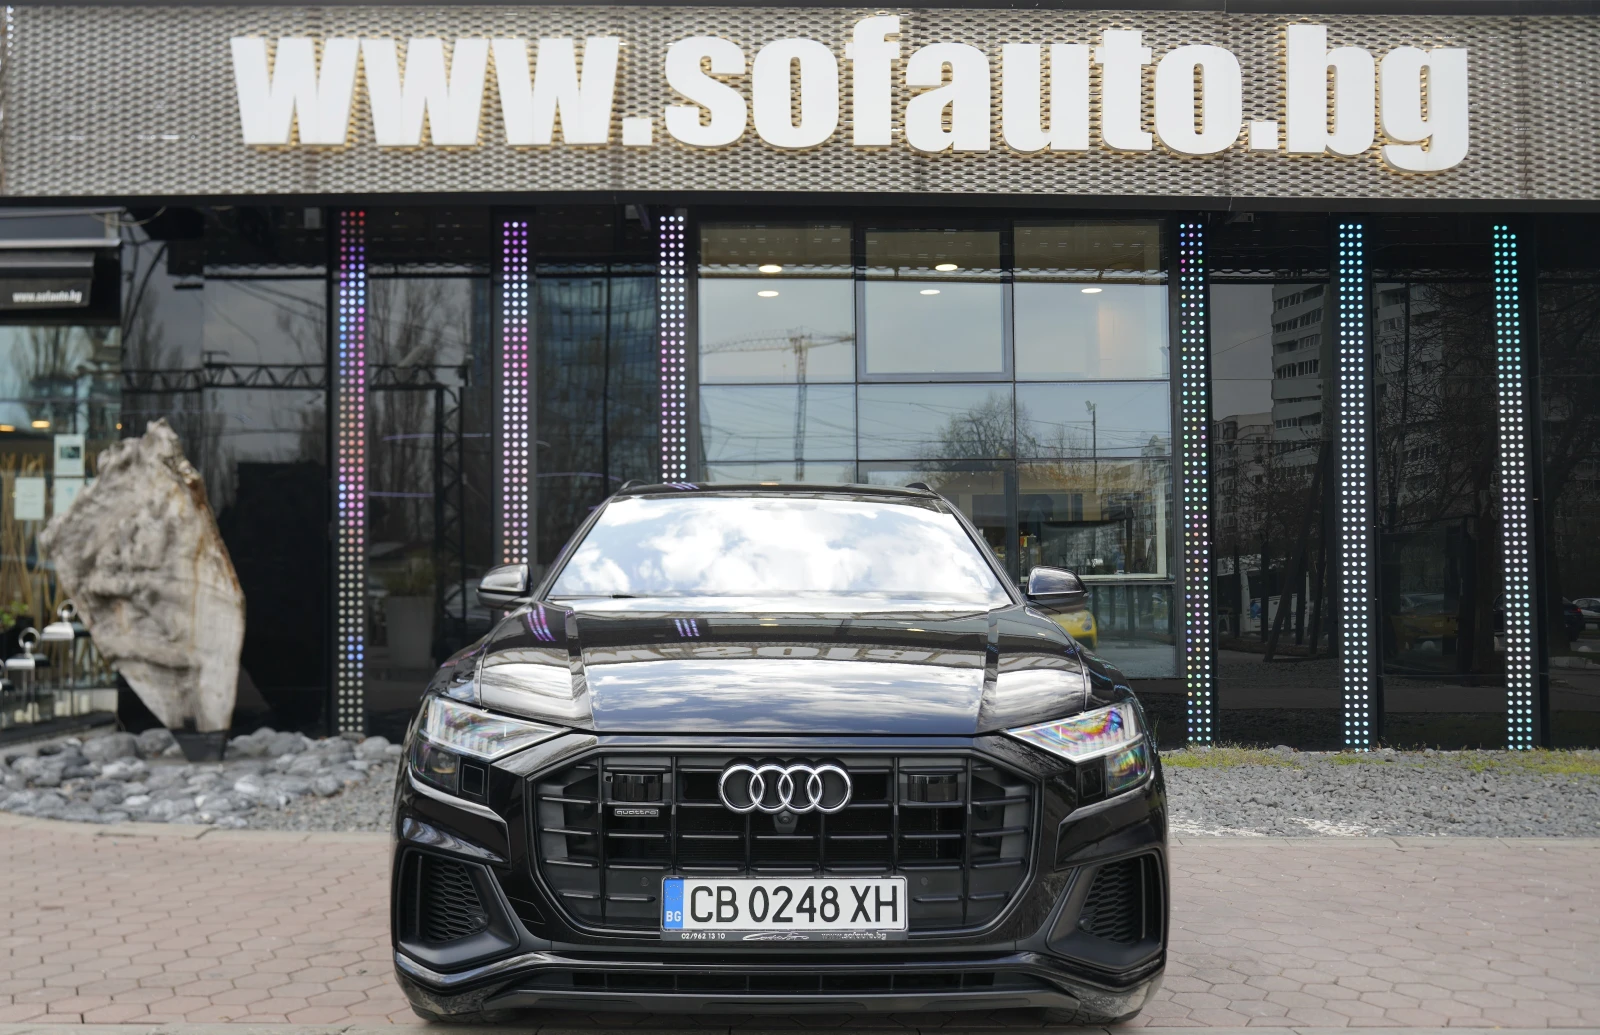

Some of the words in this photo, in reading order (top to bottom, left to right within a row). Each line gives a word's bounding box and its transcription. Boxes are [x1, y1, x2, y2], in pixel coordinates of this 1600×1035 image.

[229, 14, 1469, 173] www.sofauto.bg
[665, 910, 682, 922] BG
[690, 885, 739, 923] CB
[748, 885, 840, 923] 0248
[849, 885, 898, 923] XH
[821, 931, 887, 941] www.sofauto.bg
